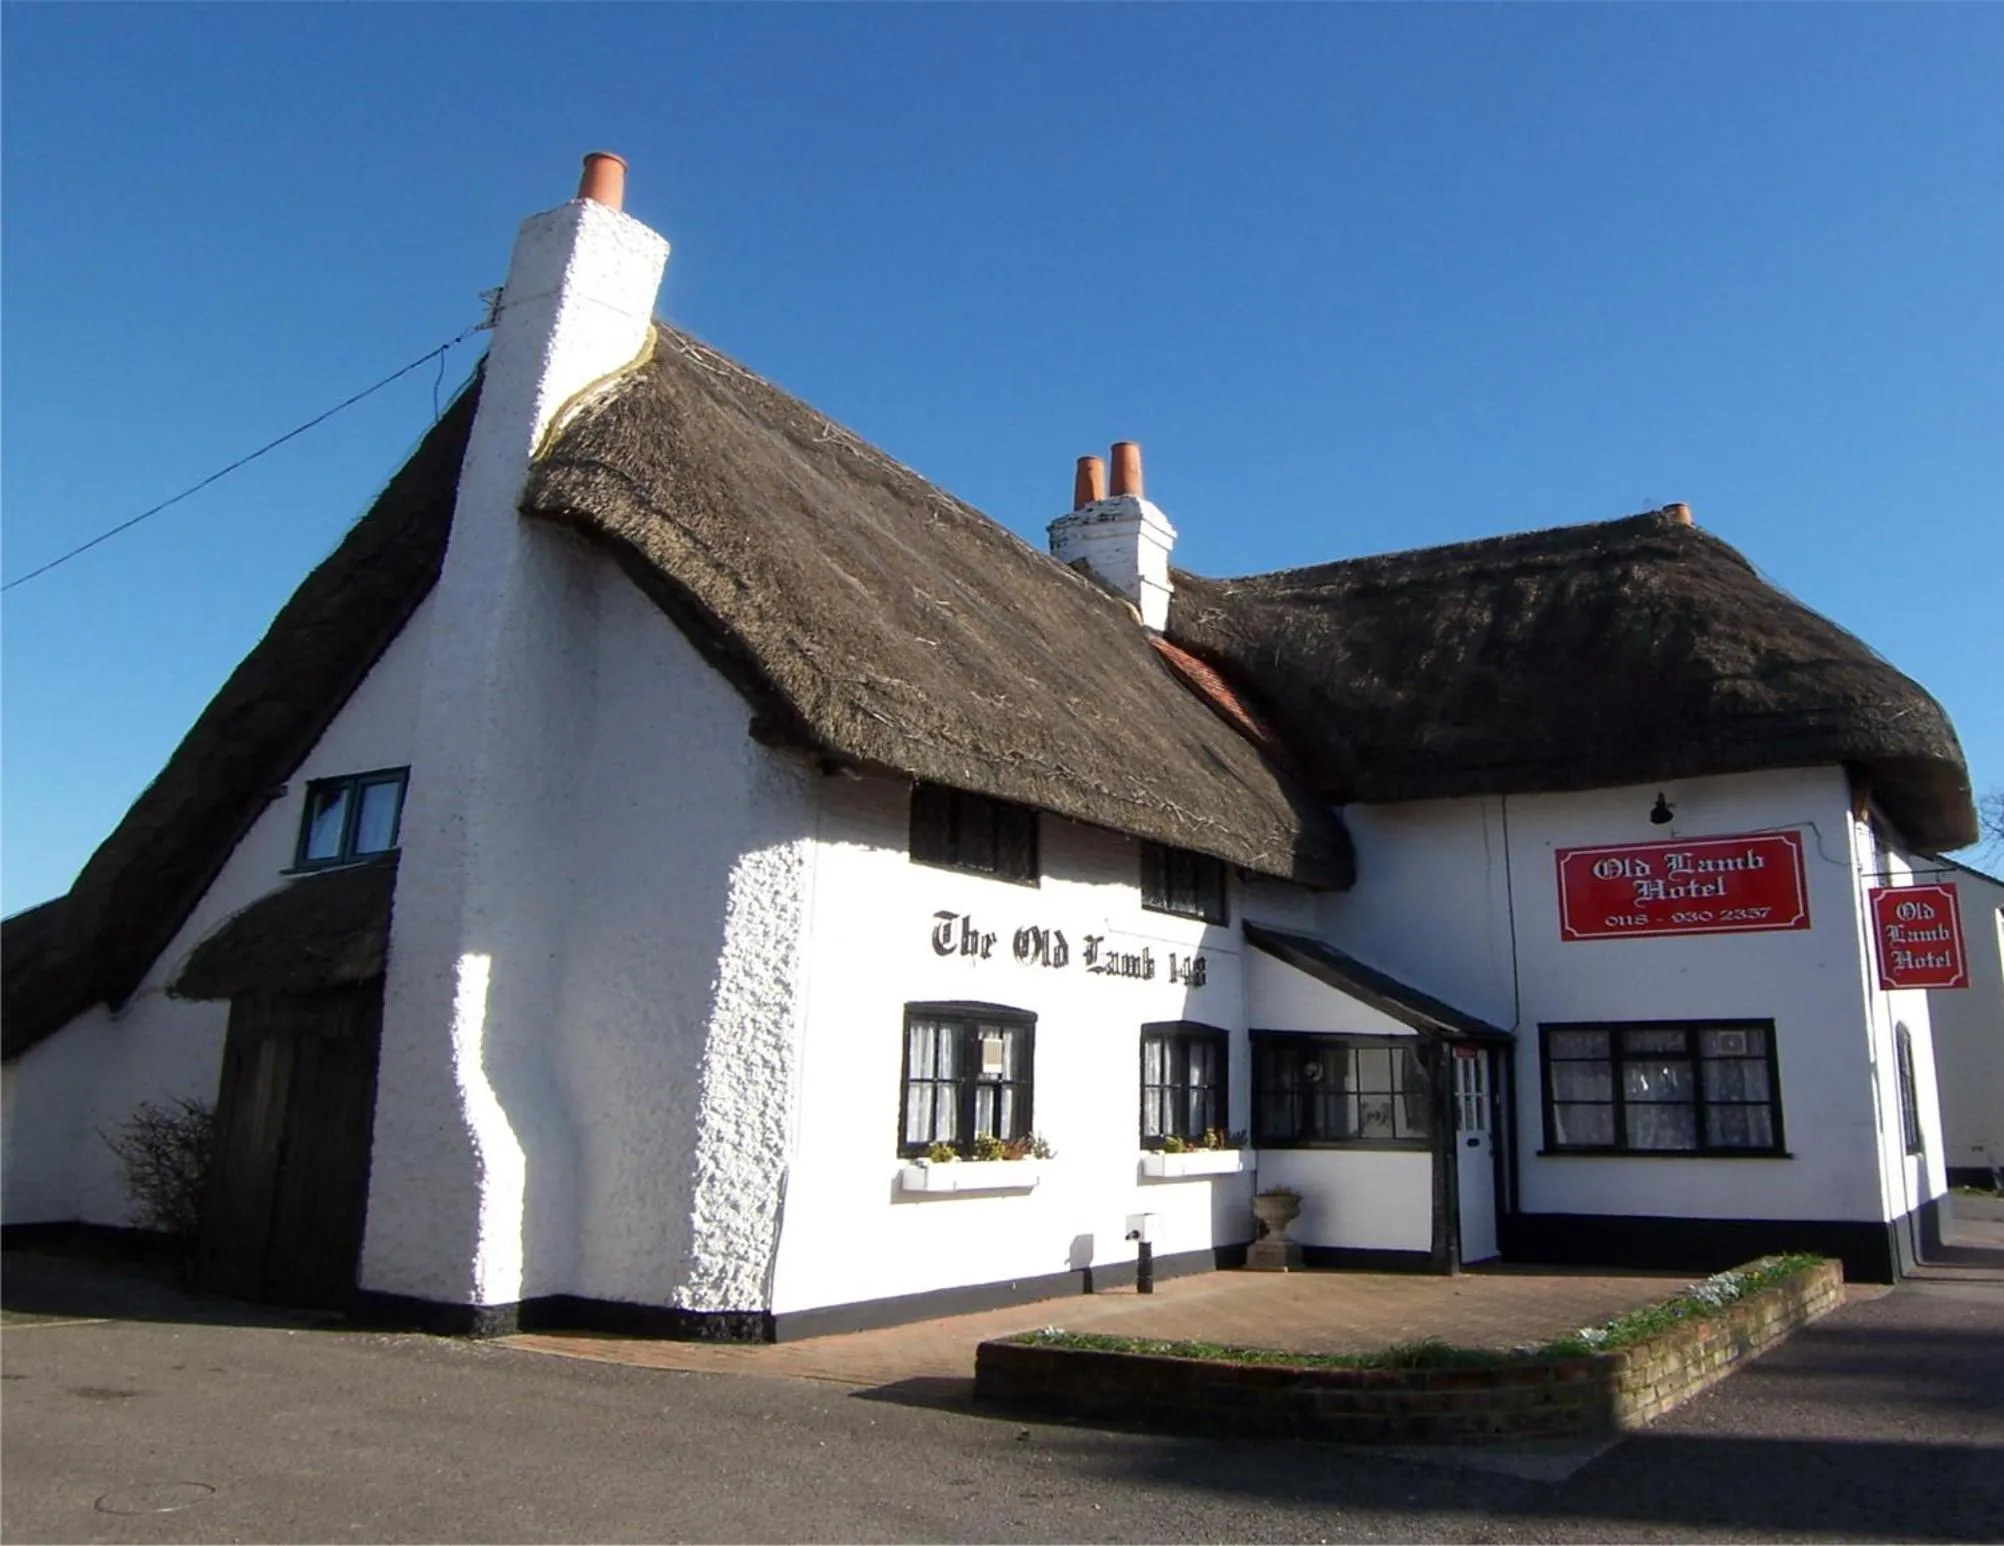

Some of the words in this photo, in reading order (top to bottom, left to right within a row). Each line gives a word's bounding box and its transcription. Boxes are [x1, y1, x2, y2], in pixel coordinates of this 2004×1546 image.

[1592, 858, 1651, 881] Old
[1664, 848, 1766, 882] Lamb
[1632, 875, 1727, 909] Hotel
[1895, 902, 1935, 921] Old
[931, 910, 997, 960] The
[1012, 925, 1070, 969] Old
[1083, 934, 1155, 981] Lamb
[1885, 924, 1951, 949] Lamb
[1890, 950, 1952, 976] Hotel
